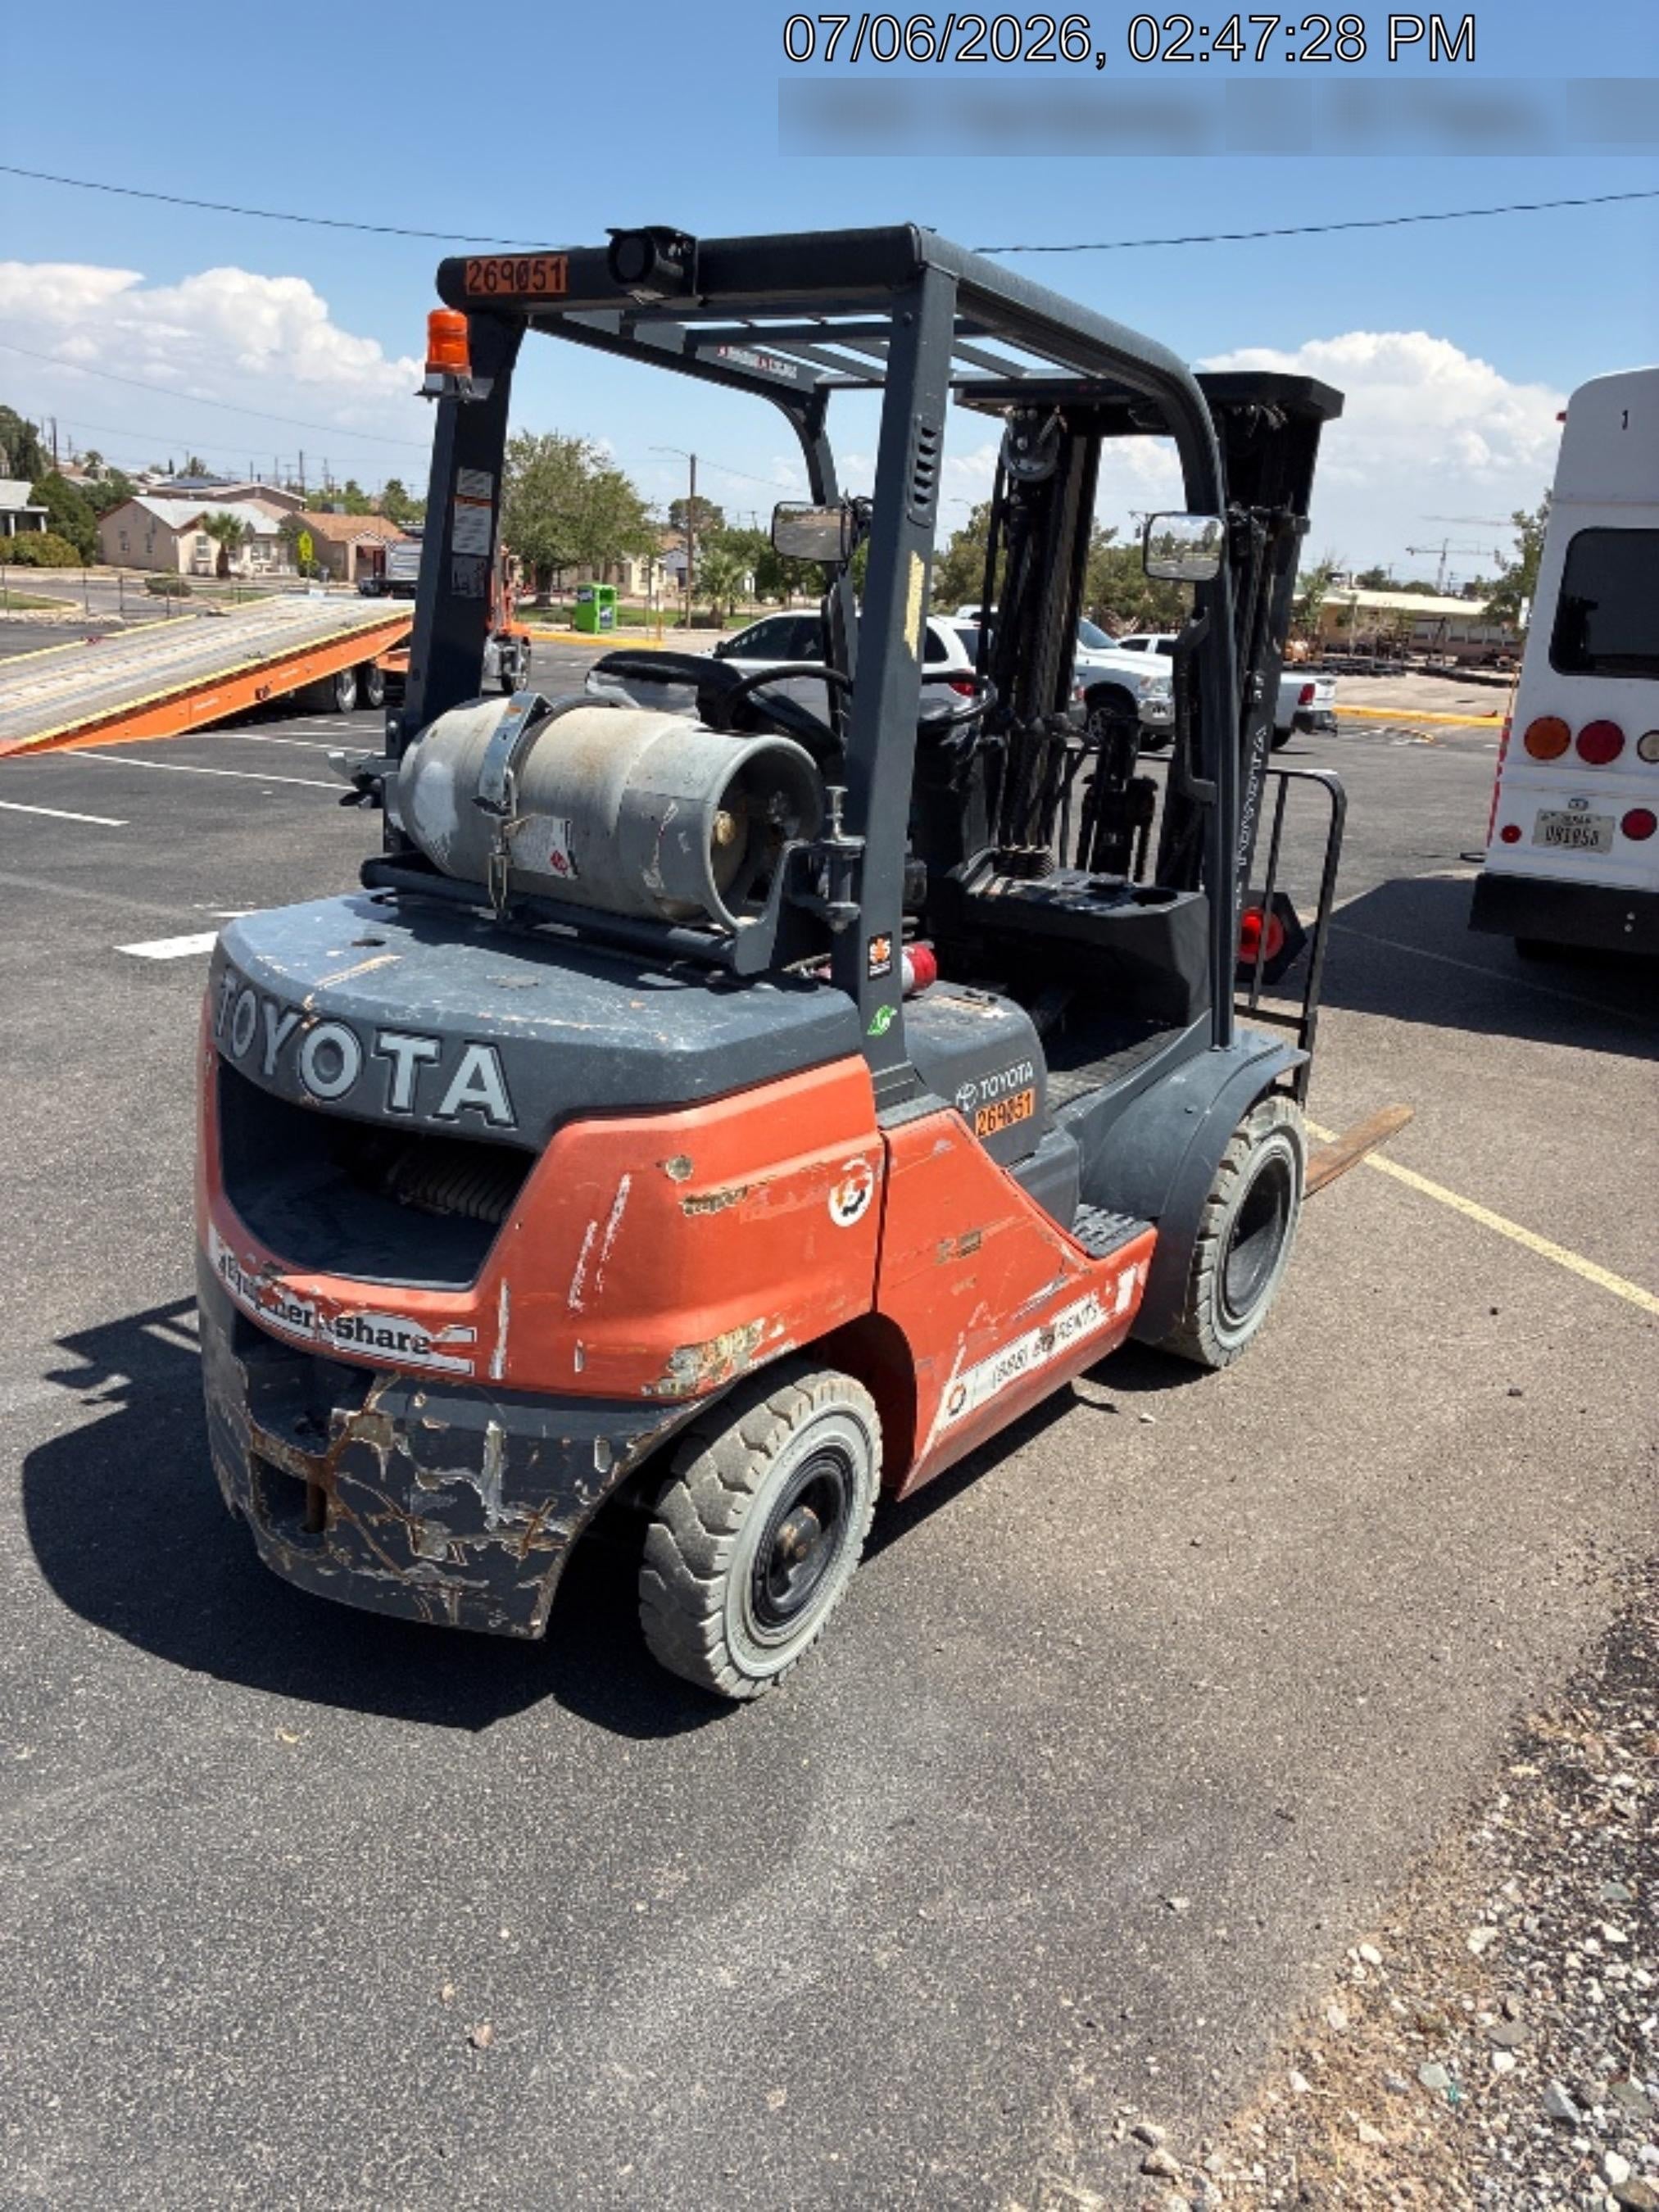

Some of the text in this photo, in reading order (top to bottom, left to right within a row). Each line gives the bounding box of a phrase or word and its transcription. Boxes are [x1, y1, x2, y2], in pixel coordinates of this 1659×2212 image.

[468, 258, 561, 292] 269051
[1621, 409, 1629, 431] 1
[216, 968, 518, 1130] TOYOTA
[980, 1061, 1033, 1099] TOYOTA
[977, 1092, 1031, 1136] 269051
